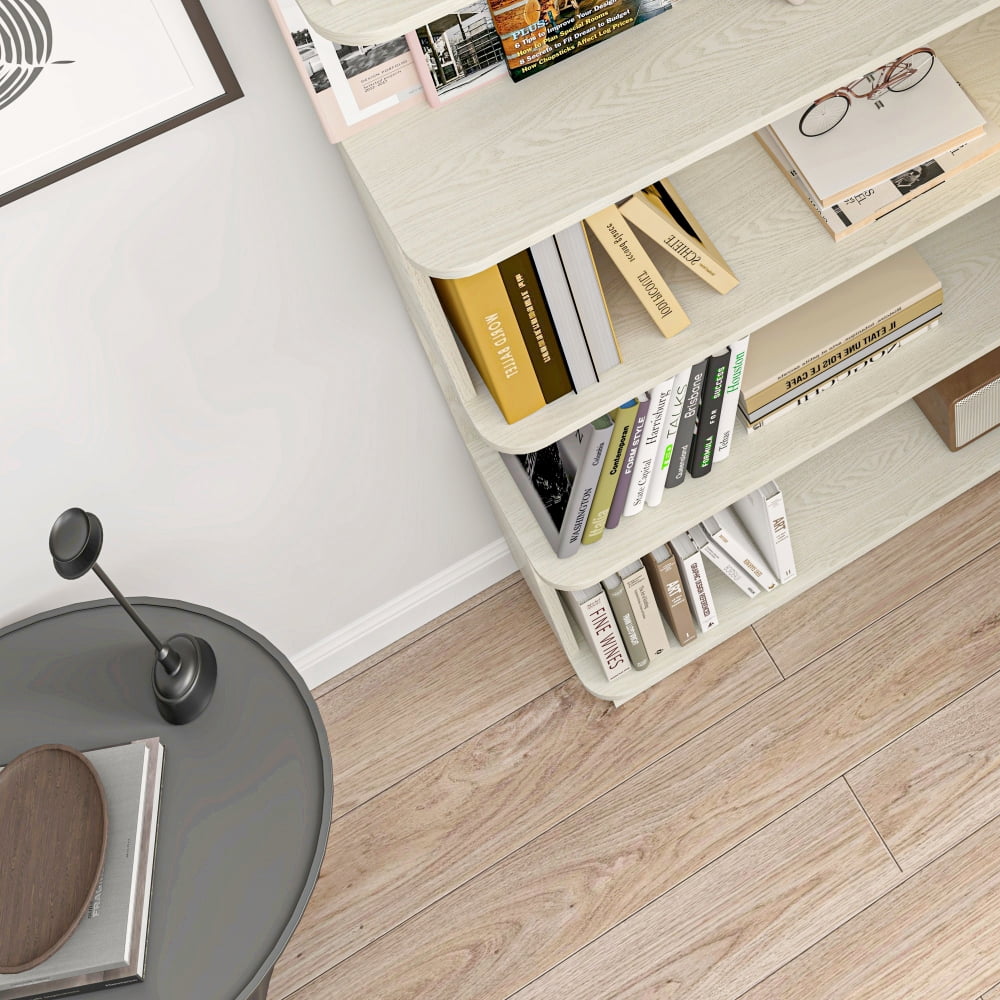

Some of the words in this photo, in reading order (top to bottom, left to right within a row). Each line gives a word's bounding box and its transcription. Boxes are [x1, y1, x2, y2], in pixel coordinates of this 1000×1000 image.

[512, 19, 549, 40] PLUS:
[517, 47, 532, 57] How
[543, 35, 559, 45] Plan
[560, 21, 584, 37] Special
[586, 11, 609, 24] Rooms
[521, 63, 537, 73] How
[539, 45, 575, 65] Chopsticks
[577, 33, 598, 47] Affect
[599, 28, 611, 36] Log
[612, 18, 633, 30] Prices
[522, 36, 536, 45] Tips
[547, 17, 575, 33] Improve
[577, 10, 592, 19] Your
[527, 47, 553, 61] Secrets
[563, 36, 573, 44] Fit
[574, 26, 596, 39] Dream
[606, 9, 630, 24] Budget
[684, 373, 702, 419] Brisbane
[727, 352, 745, 394] Houston
[646, 390, 671, 446] Harrisburg
[667, 384, 688, 439] TALKS
[701, 435, 713, 467] FORMULA
[714, 366, 725, 399] SUCCESS
[625, 446, 637, 474] FORM
[633, 416, 646, 446] STYLE
[569, 487, 592, 543] WASHINGTON
[773, 516, 786, 534] ART
[666, 580, 682, 597] ART
[589, 607, 611, 636] FINE
[600, 632, 624, 670] WINES
